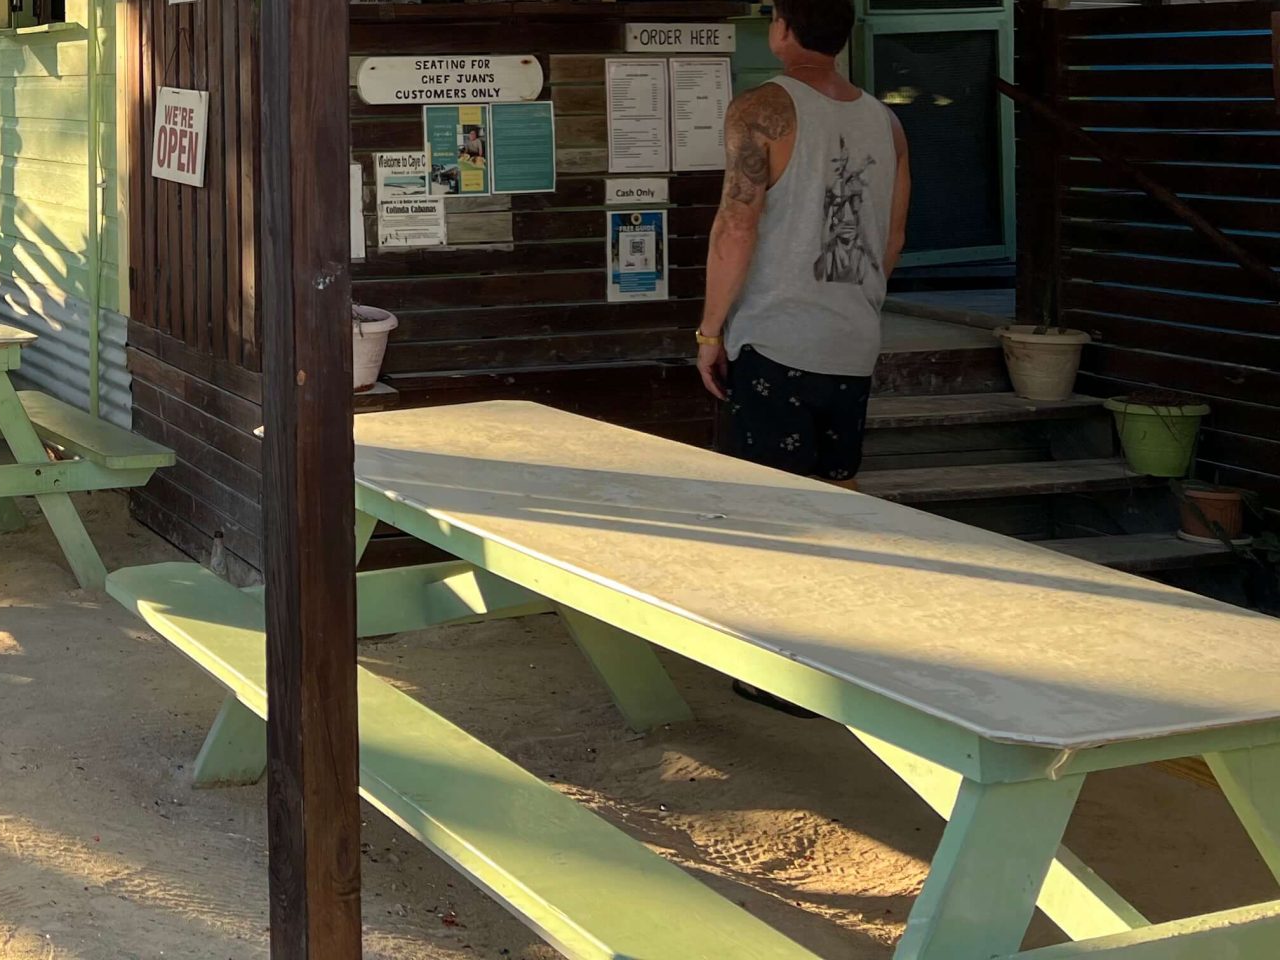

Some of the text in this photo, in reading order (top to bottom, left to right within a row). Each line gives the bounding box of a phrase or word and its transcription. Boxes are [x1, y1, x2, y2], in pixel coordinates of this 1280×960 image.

[639, 29, 719, 45] ORDER HERE
[415, 59, 490, 70] SEATING FOR
[421, 73, 495, 84] CHEF JUAN'S
[395, 88, 501, 100] CUSTOMERS ONLY
[164, 104, 194, 129] WE'RE
[157, 125, 199, 175] OPEN
[378, 154, 401, 168] Welcome
[401, 156, 407, 168] to
[615, 187, 655, 198] Cash Only
